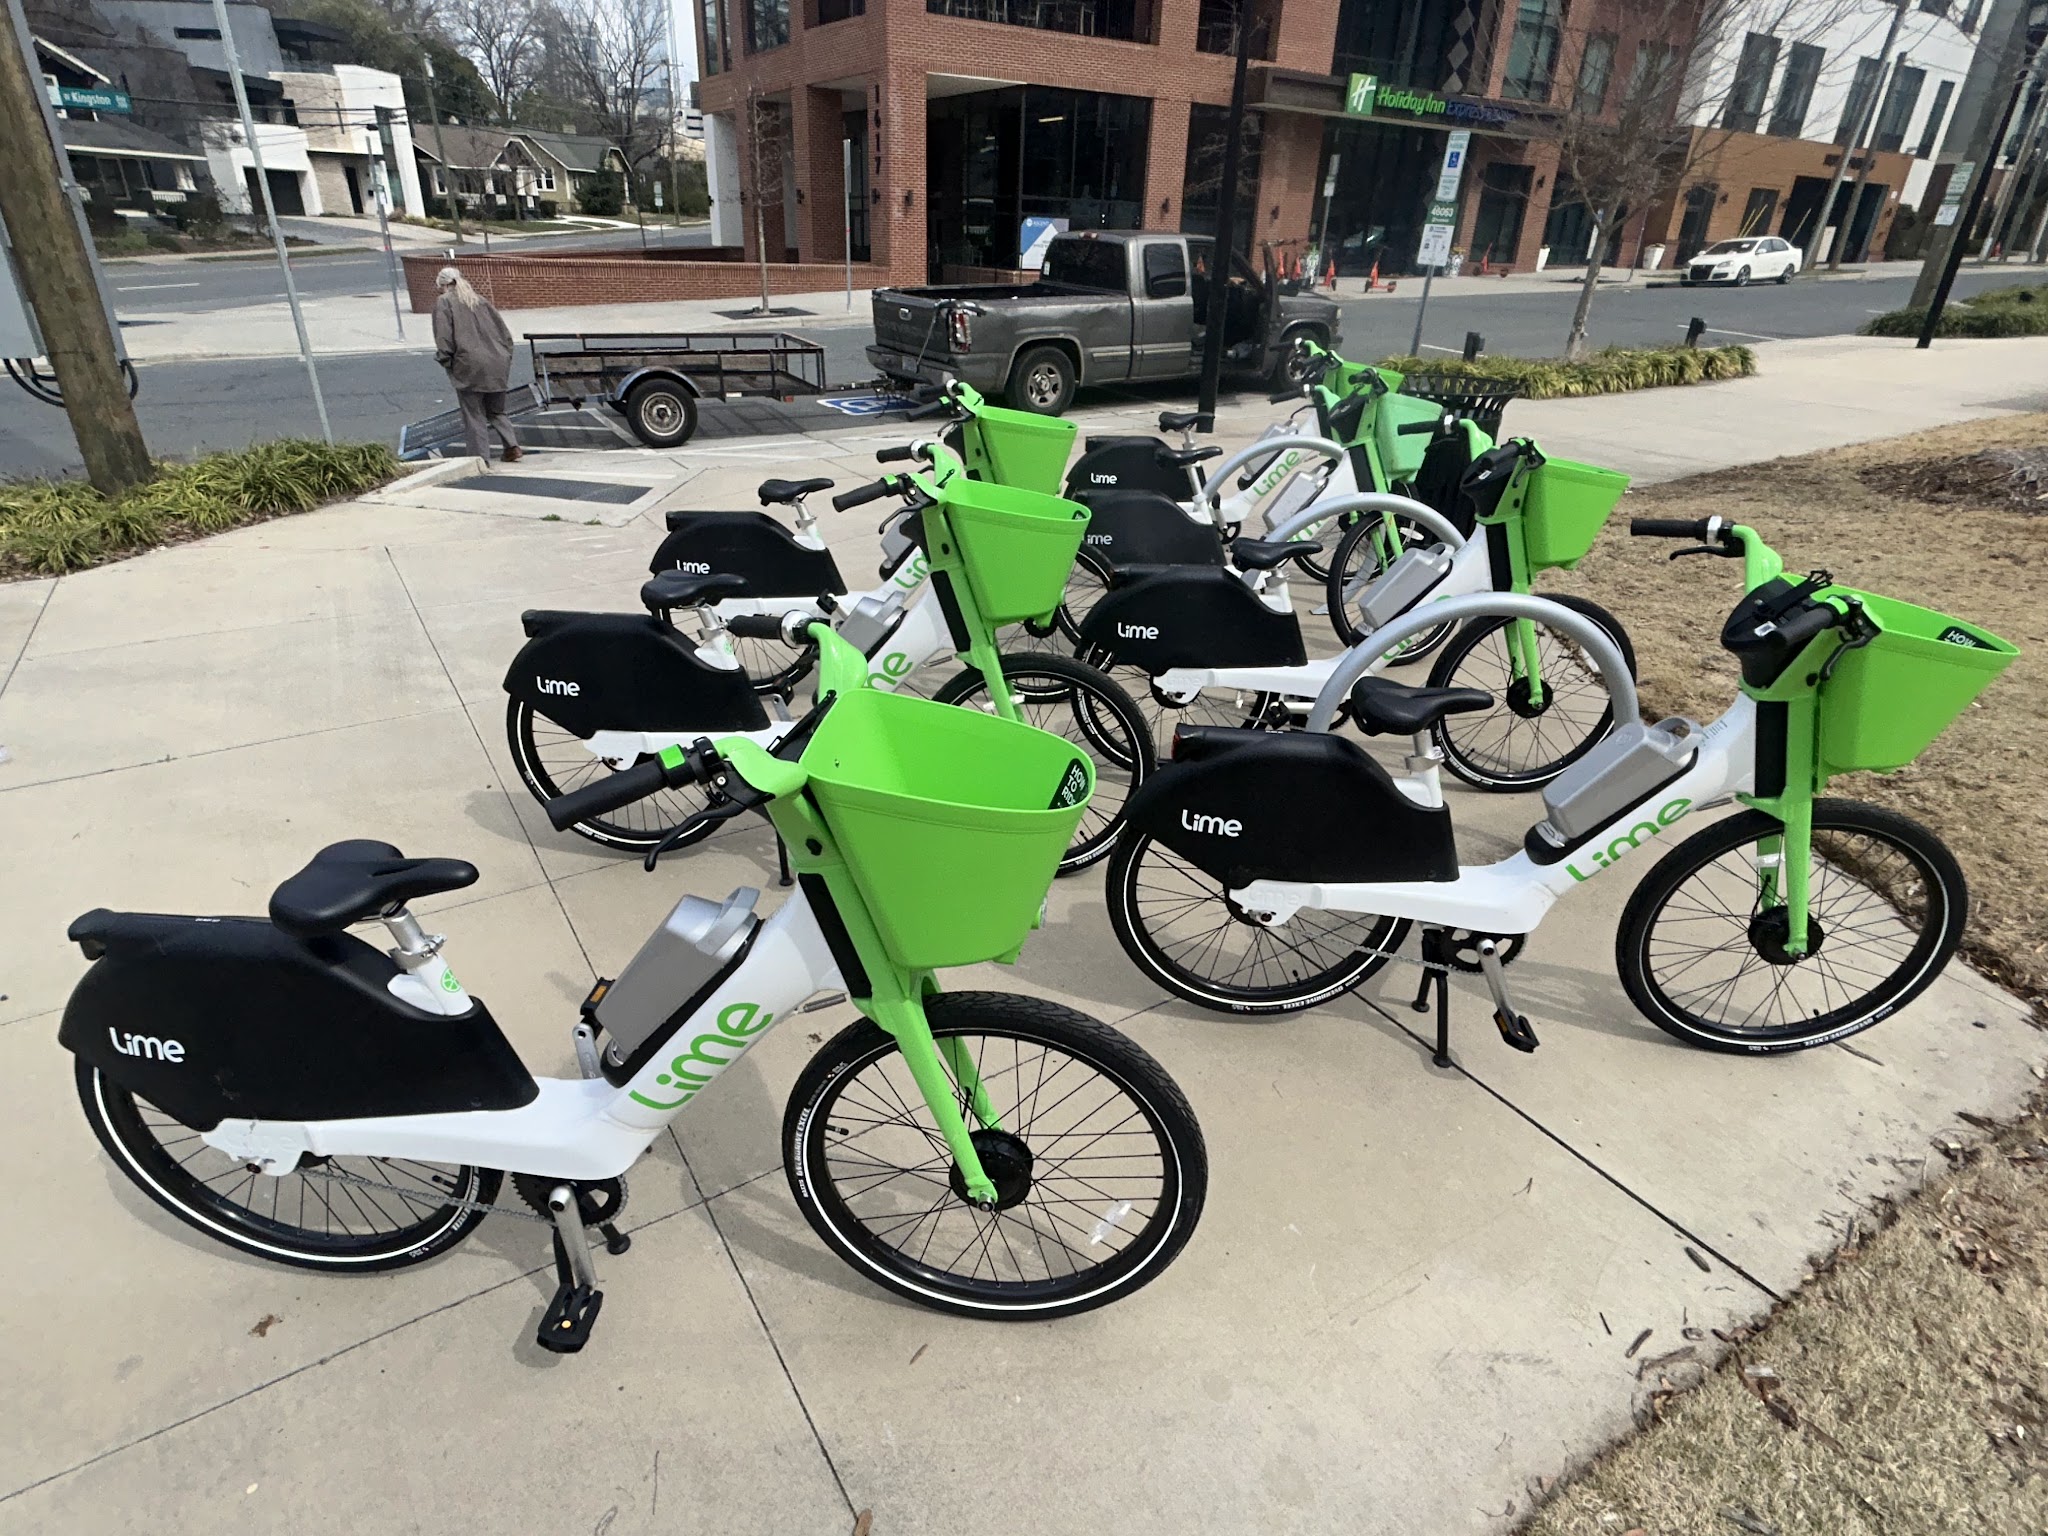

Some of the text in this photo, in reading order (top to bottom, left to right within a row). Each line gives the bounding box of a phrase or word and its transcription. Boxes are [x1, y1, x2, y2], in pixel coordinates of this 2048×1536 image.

[71, 91, 112, 107] Kingston
[1378, 86, 1426, 116] Holiday
[1426, 93, 1446, 114] Inn
[873, 84, 881, 175] 1617
[1090, 472, 1118, 484] Lime
[1253, 451, 1300, 496] Lime
[1082, 534, 1113, 545] ime
[676, 559, 711, 574] Lime
[1117, 622, 1159, 639] Lime
[536, 675, 581, 697] Lime
[1067, 775, 1078, 792] TO
[1071, 765, 1086, 791] HOW
[1181, 809, 1243, 837] Lime
[1565, 798, 1692, 882] Lime
[109, 1026, 185, 1063] Lime
[628, 1002, 774, 1110] Lime
[797, 1107, 811, 1132] EXCEL
